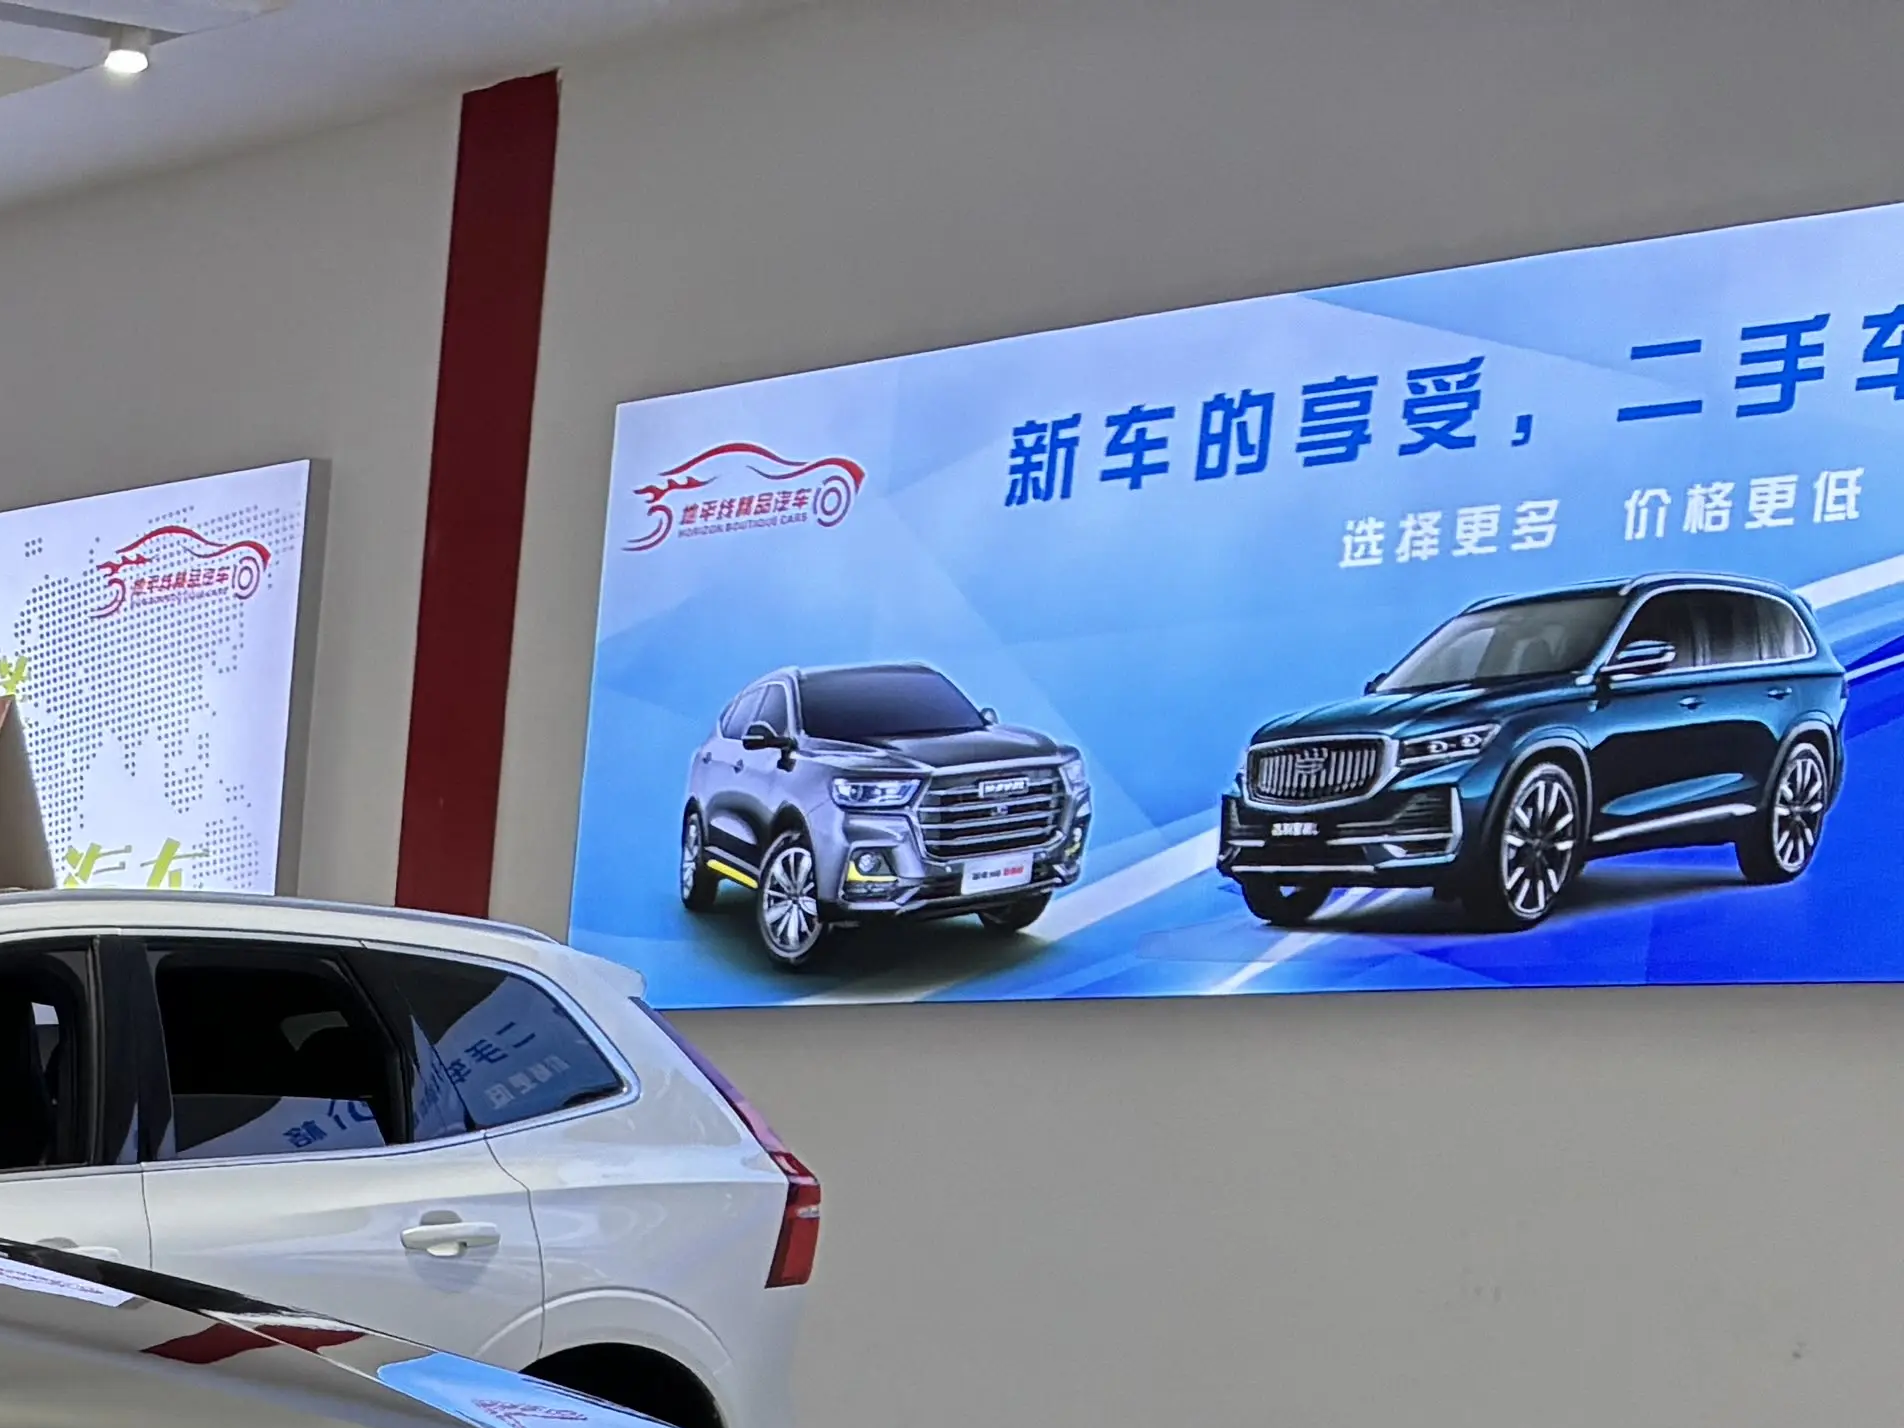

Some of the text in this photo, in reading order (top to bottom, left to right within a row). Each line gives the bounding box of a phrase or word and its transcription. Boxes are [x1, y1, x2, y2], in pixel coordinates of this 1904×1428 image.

[1339, 466, 1865, 569] 选择更多 价格更低
